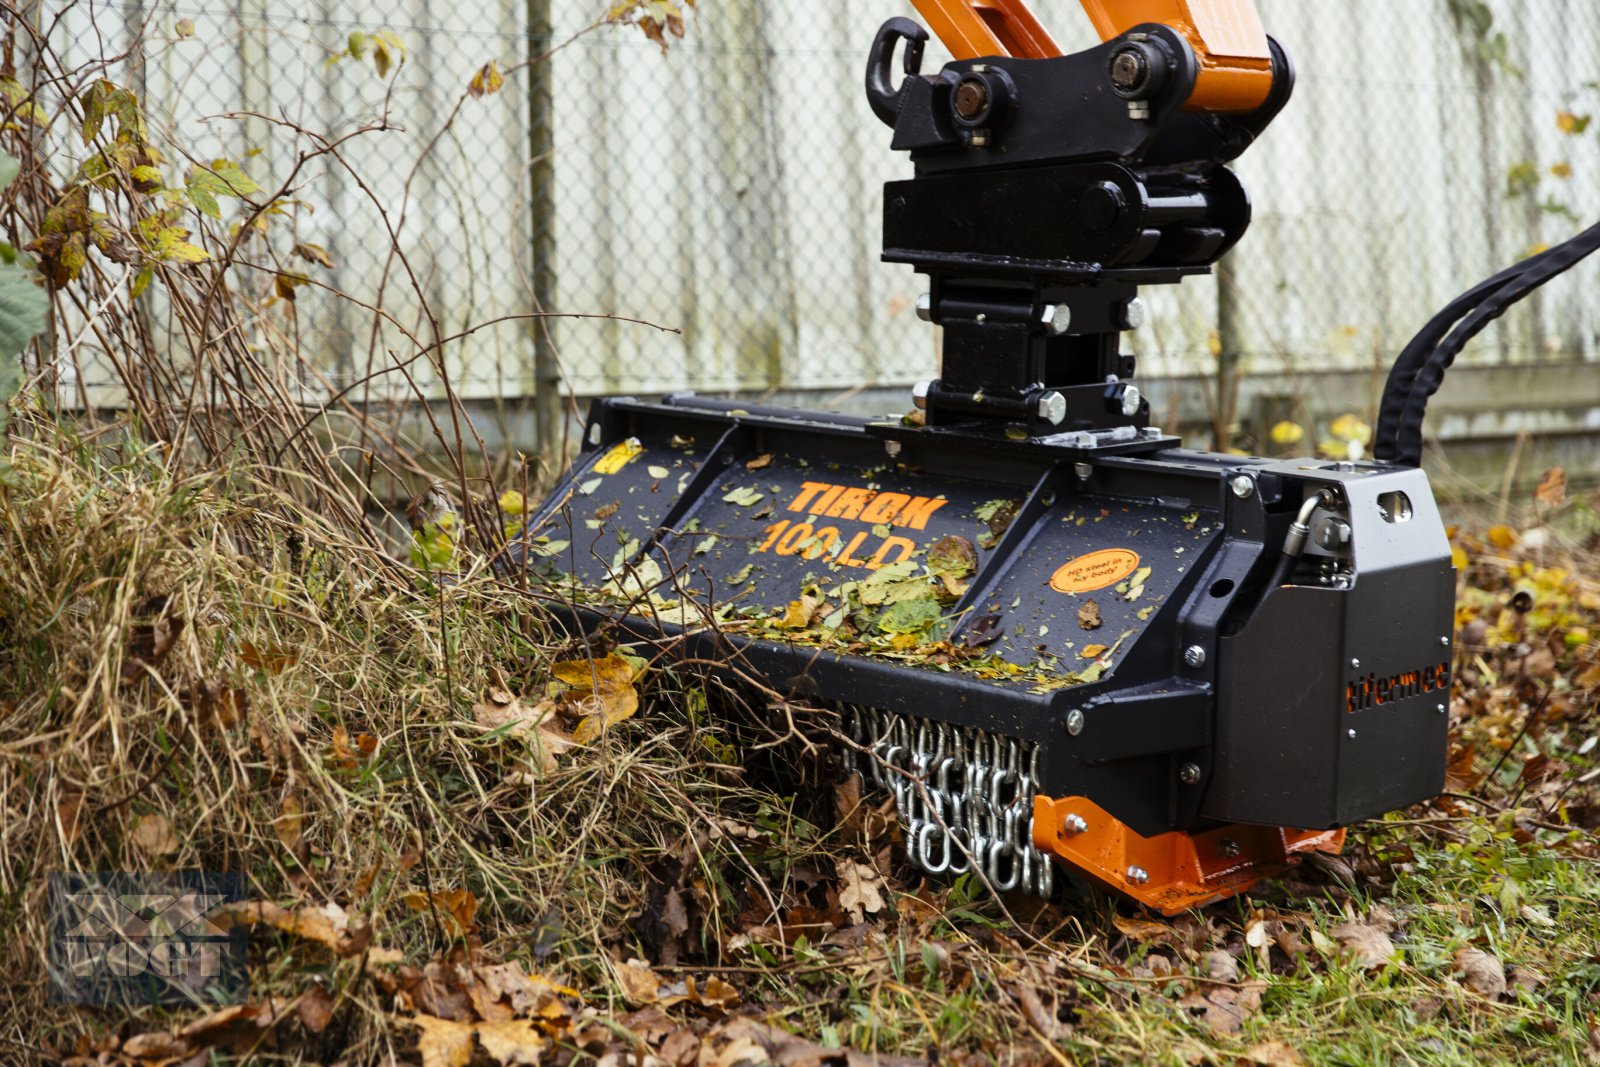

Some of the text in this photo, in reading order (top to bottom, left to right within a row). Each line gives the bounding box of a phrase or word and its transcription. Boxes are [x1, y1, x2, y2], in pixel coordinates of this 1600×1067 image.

[787, 481, 949, 530] TIROK
[1067, 568, 1083, 577] HD
[1086, 560, 1110, 572] steel
[1346, 662, 1448, 713] tifermec
